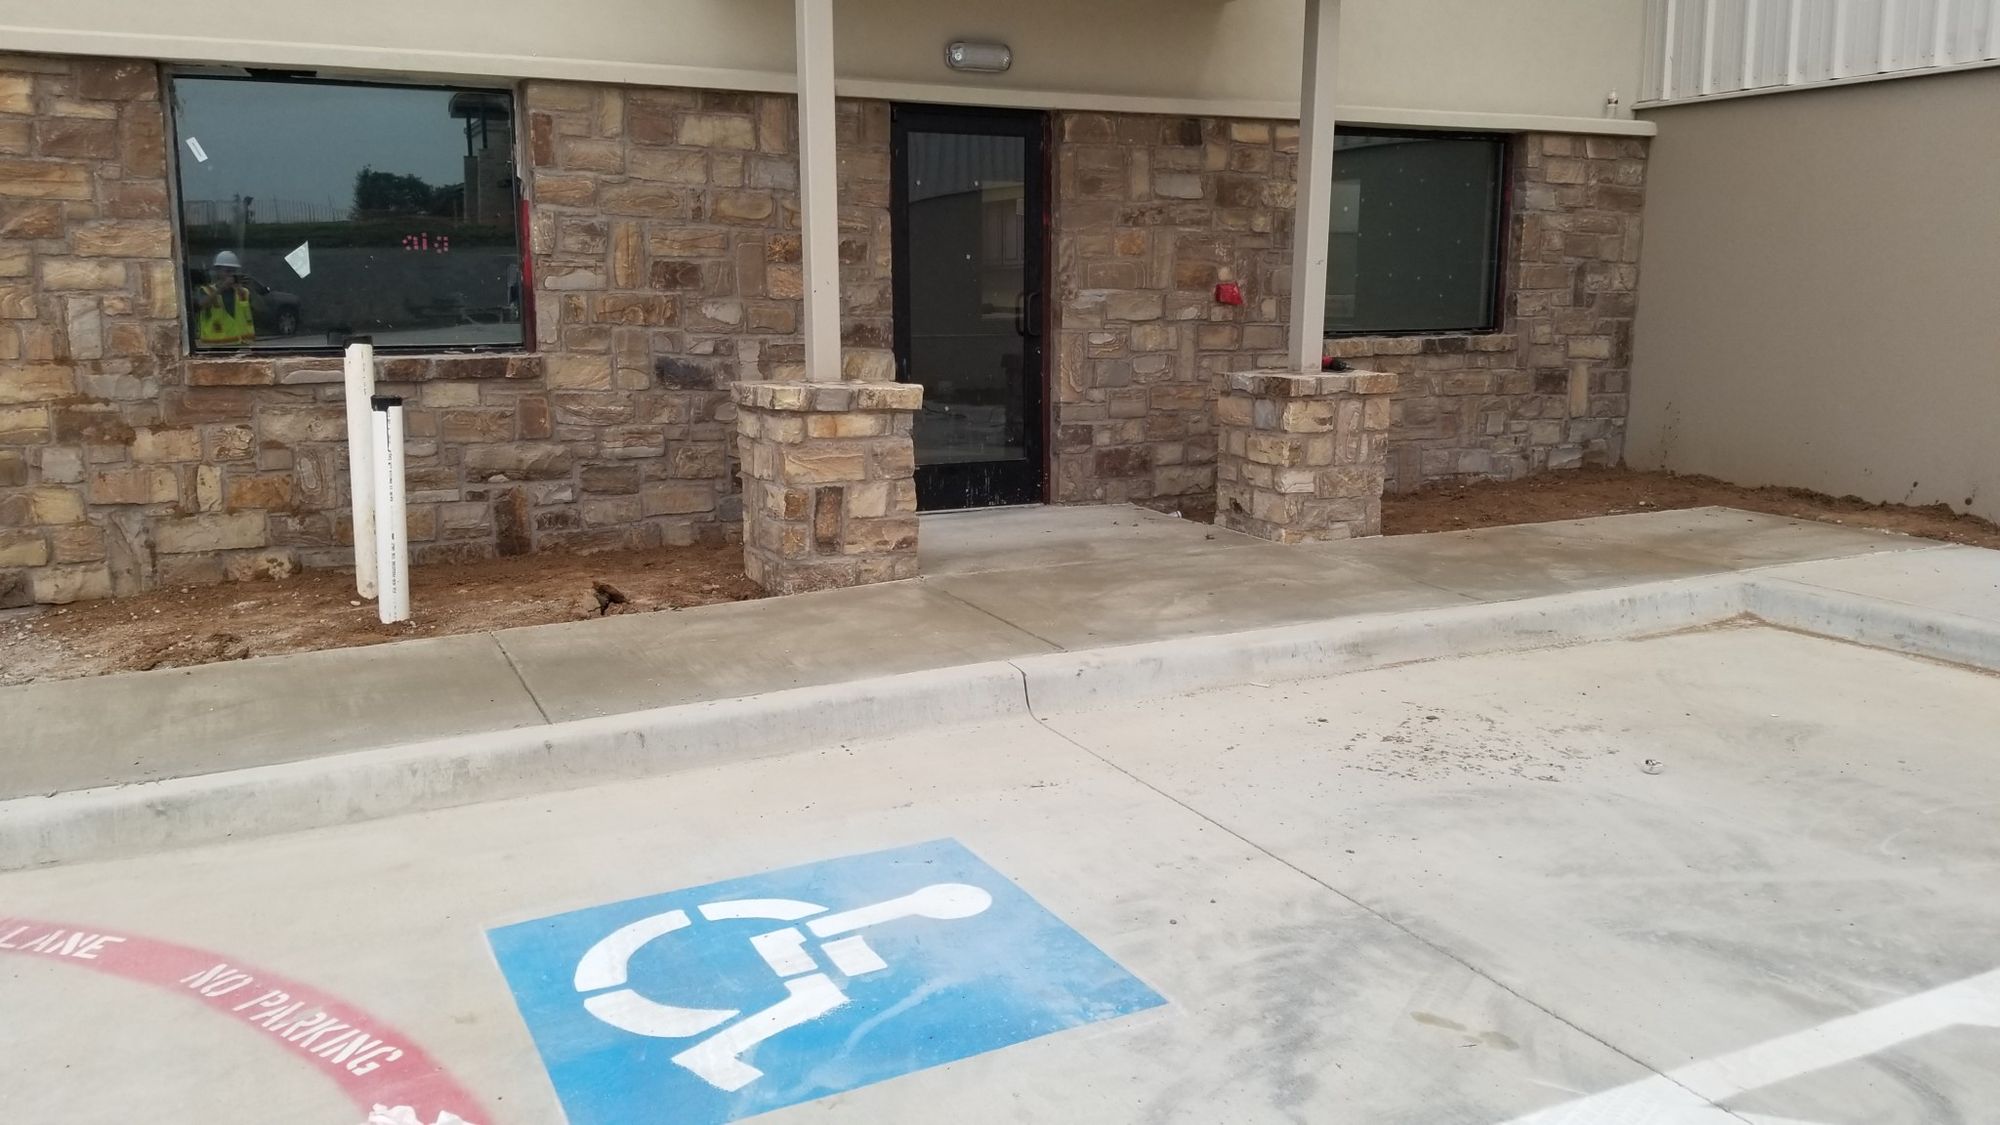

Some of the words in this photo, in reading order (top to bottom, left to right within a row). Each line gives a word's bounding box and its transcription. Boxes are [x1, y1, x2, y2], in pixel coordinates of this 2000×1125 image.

[0, 926, 127, 959] LANE
[179, 963, 253, 997] NO
[232, 989, 404, 1076] PARKING
